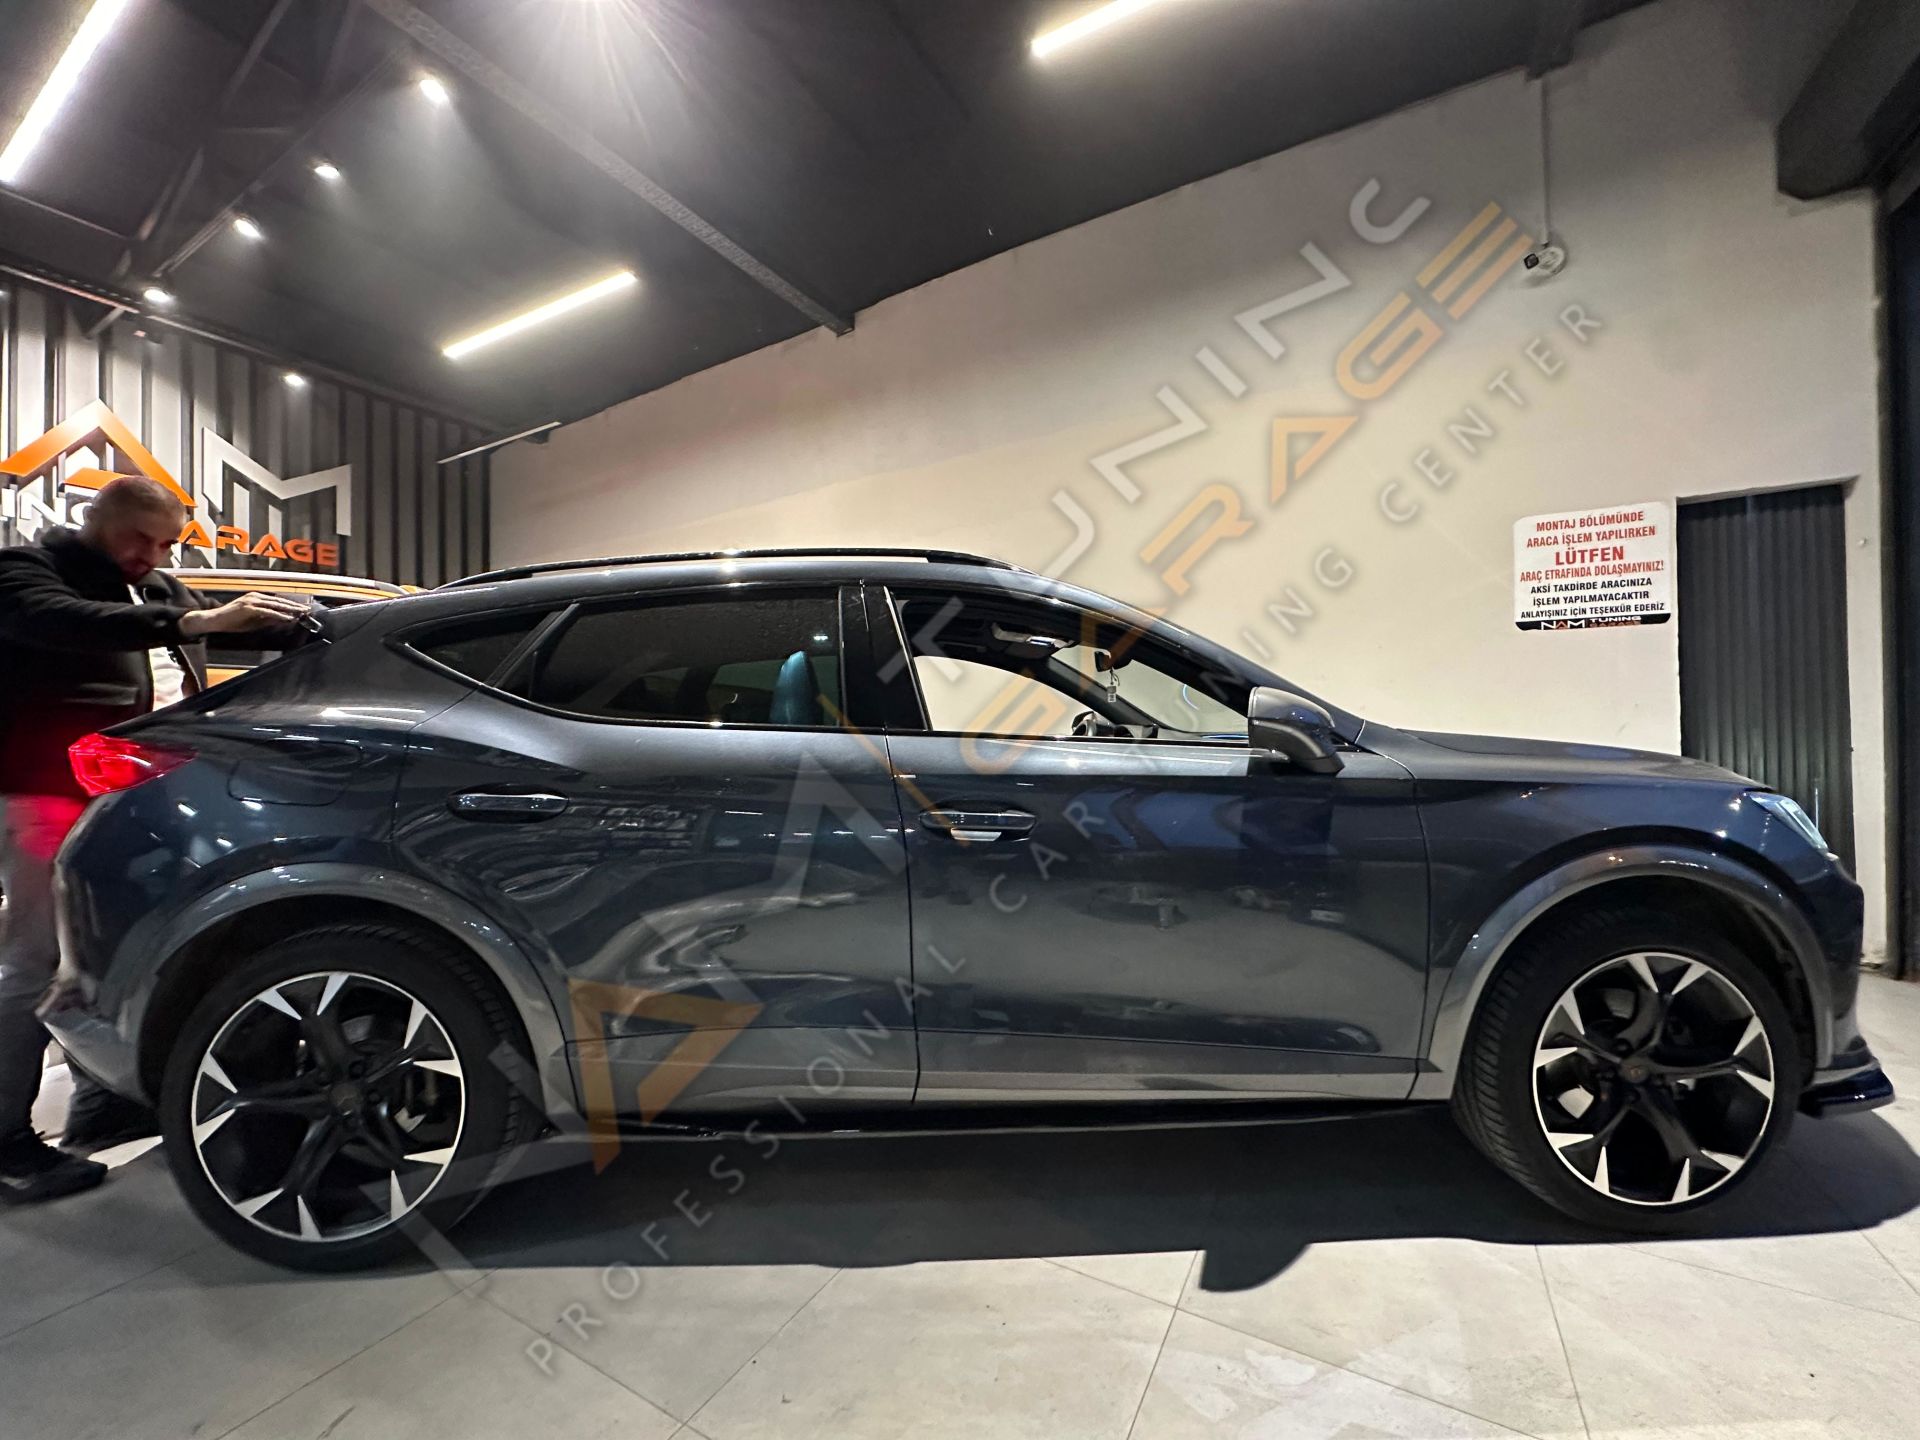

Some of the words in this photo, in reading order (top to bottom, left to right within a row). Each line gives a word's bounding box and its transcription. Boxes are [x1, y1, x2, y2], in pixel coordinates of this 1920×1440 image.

[1536, 518, 1576, 532] MONTAJ
[1580, 511, 1644, 528] BÖLÜMÜNDE
[178, 520, 339, 567] ARAGE
[1527, 536, 1559, 548] ARACA
[1562, 532, 1593, 546] İŞLEM
[1596, 526, 1656, 541] YAPILIRKEN
[1555, 546, 1624, 566] LÜTFEN
[1520, 571, 1542, 583] ARAÇ
[1545, 566, 1592, 580] ETRAFINDA
[1595, 560, 1664, 577] DOLAŞMAYINIZ!
[1531, 583, 1550, 594] AKSİ
[1553, 581, 1598, 592] TAKDİRDE
[1600, 577, 1652, 589] ARACINIZA
[1533, 597, 1560, 608] İŞLEM
[1563, 591, 1649, 604] YAPILMAYACAKTIR
[1521, 609, 1568, 619] ANLAYIŞINIZ
[1570, 606, 1587, 617] İÇİN
[1589, 604, 1632, 615] TEŞEKKÜR
[1634, 601, 1665, 612] EDERİZ
[1541, 619, 1585, 630] NAM
